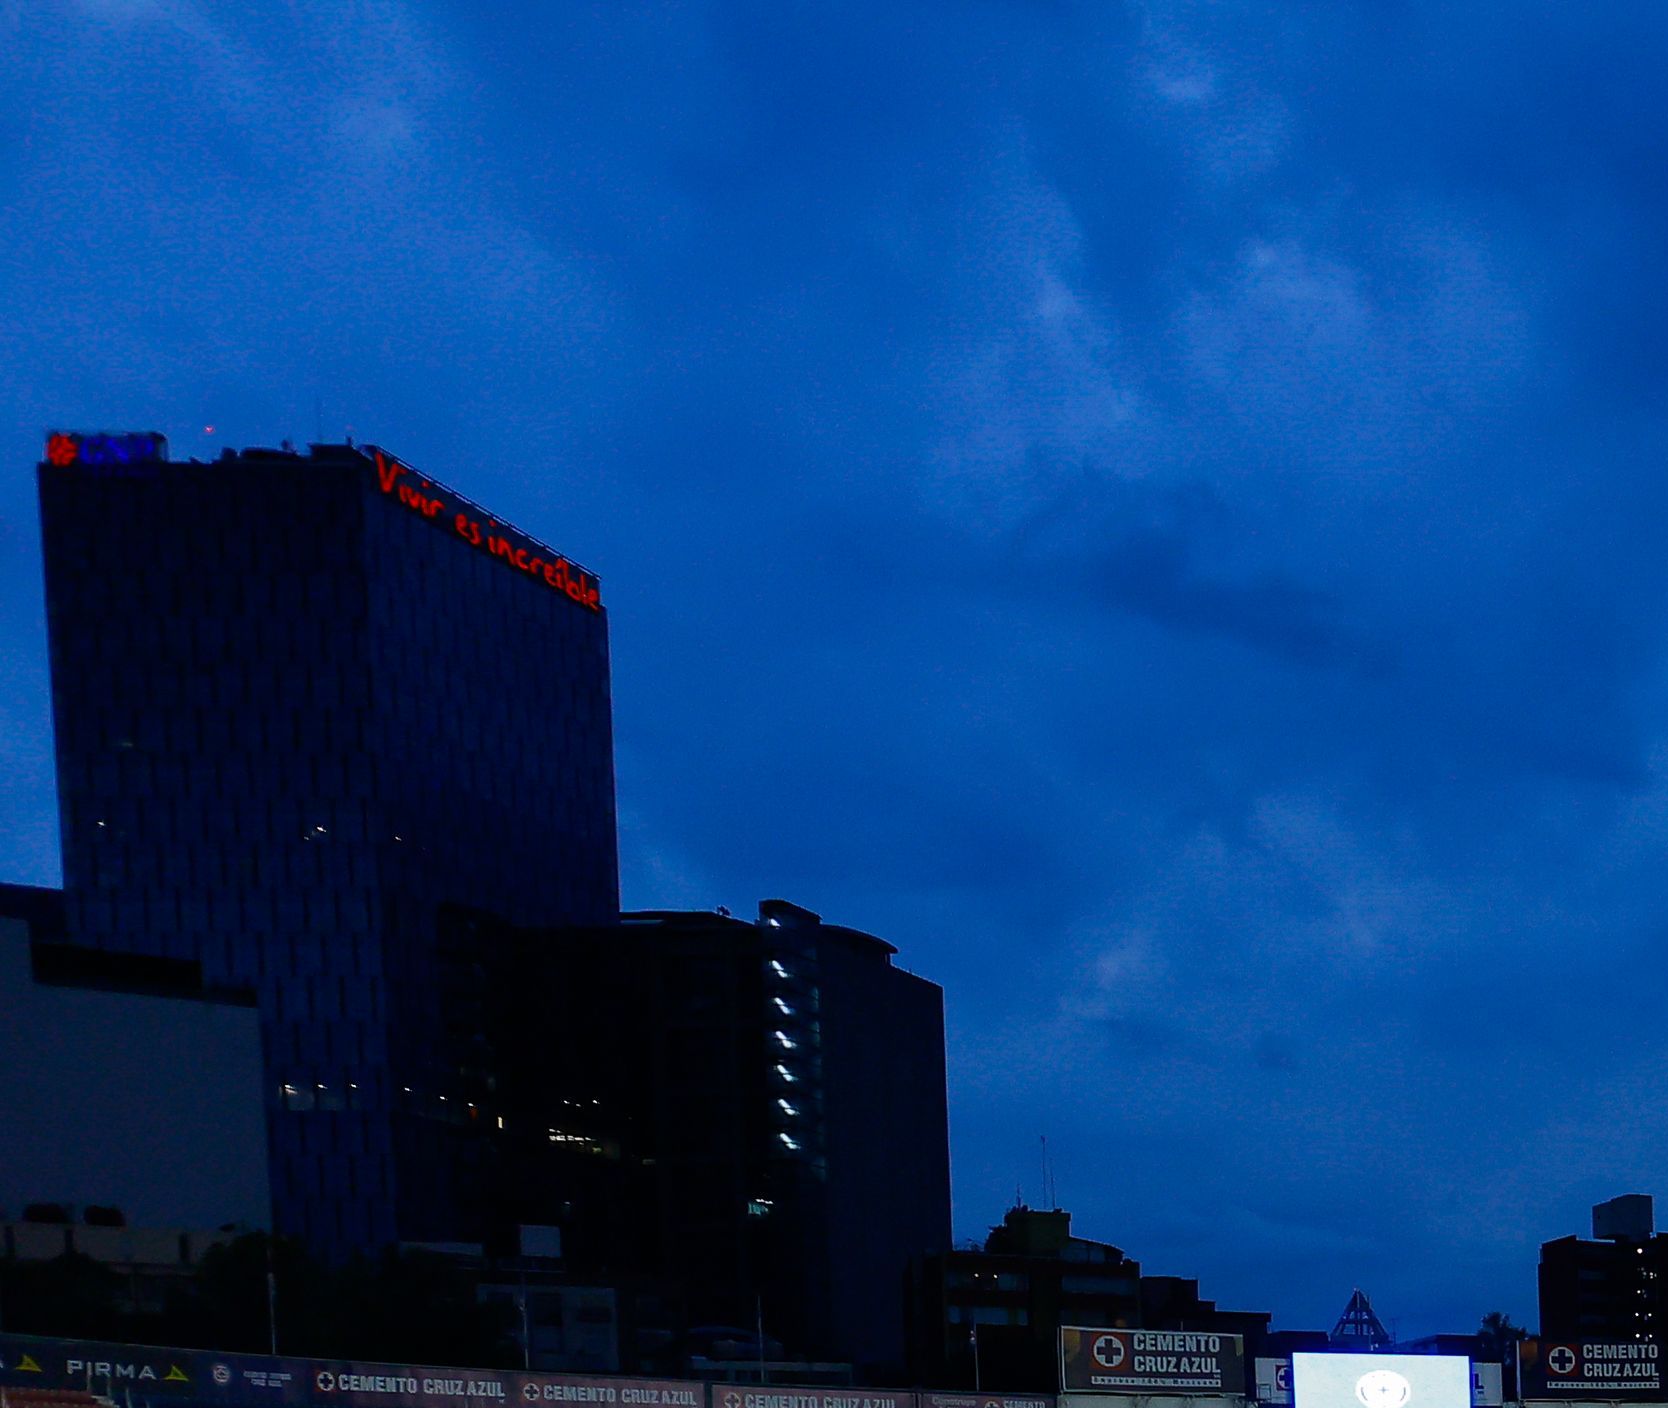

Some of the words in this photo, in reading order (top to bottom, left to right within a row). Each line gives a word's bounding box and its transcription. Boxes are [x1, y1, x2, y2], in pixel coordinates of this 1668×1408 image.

[454, 514, 481, 546] es
[1132, 1333, 1221, 1353] CEMENTO
[1583, 1344, 1659, 1360] CEMENTO
[66, 1360, 157, 1381] PIRMA
[1133, 1355, 1179, 1373] CRUZ
[1180, 1356, 1222, 1373] AZUL
[1584, 1363, 1622, 1377] CRUZ
[1623, 1363, 1660, 1377] AZUL
[338, 1374, 417, 1395] CEMENTO
[423, 1379, 465, 1397] CRUZ
[466, 1380, 506, 1398] AZUL
[543, 1384, 617, 1404] CEMENTO
[621, 1388, 660, 1405] CRUZ
[661, 1390, 698, 1406] AZUL
